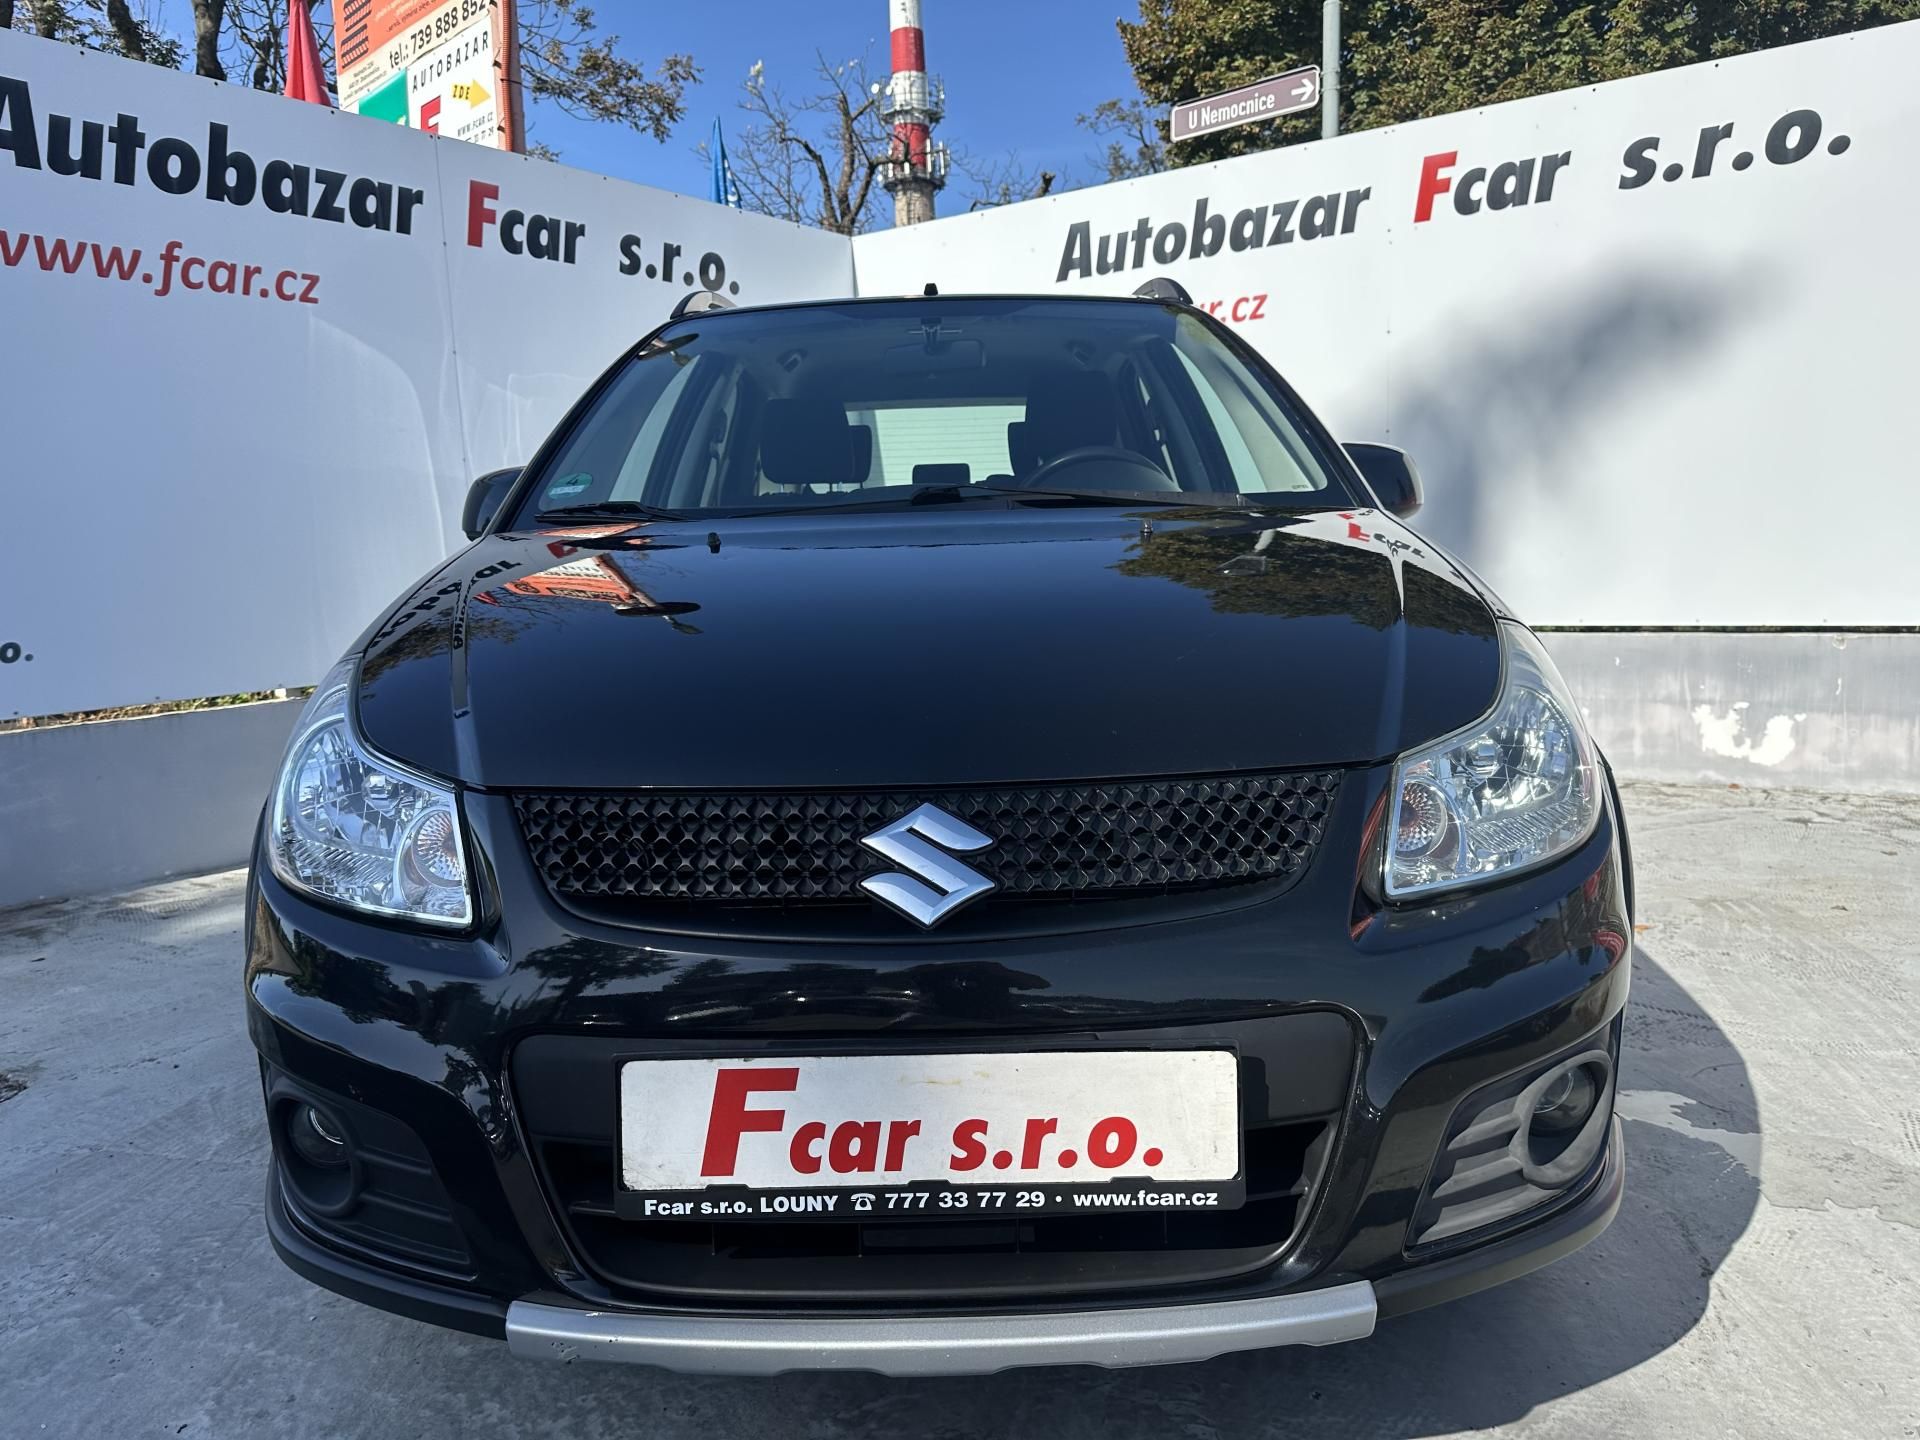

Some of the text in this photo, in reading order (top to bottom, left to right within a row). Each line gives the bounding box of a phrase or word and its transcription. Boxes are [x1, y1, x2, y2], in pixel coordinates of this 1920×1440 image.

[389, 43, 409, 69] tel.:
[411, 24, 432, 55] 739
[435, 6, 458, 38] 888
[412, 30, 489, 93] AUTOBAZAR
[453, 84, 471, 100] ZDE
[1188, 92, 1275, 130] U Nemocnice
[0, 76, 740, 295] Autobazar Fcar s.r.o.
[1056, 109, 1851, 283] Autobazar Fcar s.r.o.
[699, 1067, 1164, 1177] Fcar s.r.o.
[644, 1189, 1219, 1216] Fcar s.r.o. LOUNY 777 33 77 29 www.fcar.cz
